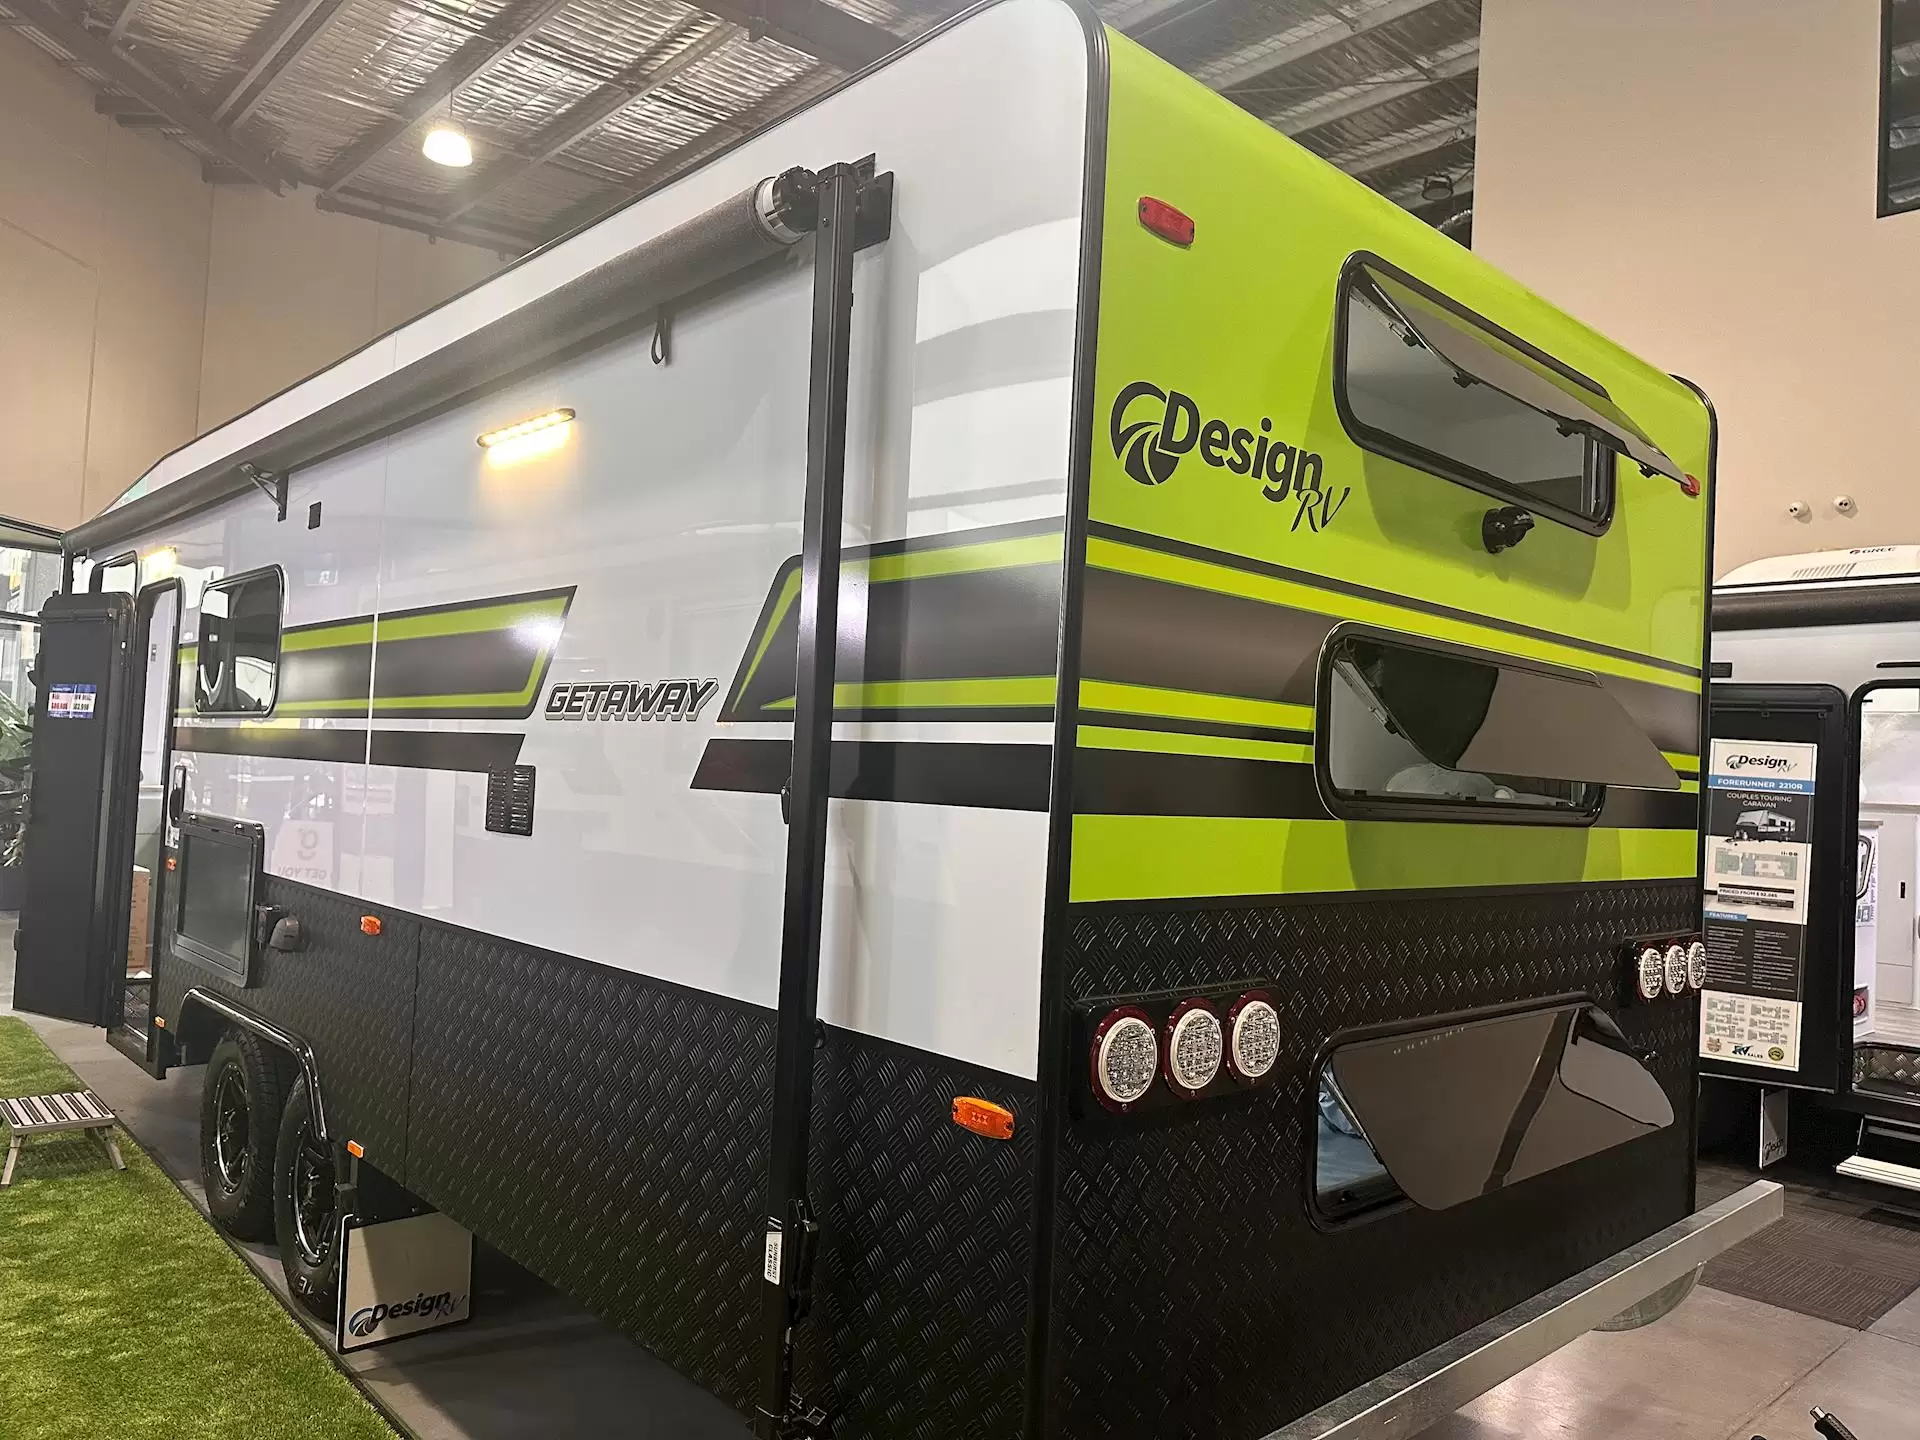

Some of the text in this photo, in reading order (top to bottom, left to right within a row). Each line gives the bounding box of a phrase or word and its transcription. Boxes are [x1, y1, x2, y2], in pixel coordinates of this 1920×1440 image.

[1157, 389, 1324, 503] Design
[1290, 485, 1352, 533] RV
[544, 677, 720, 722] GETAWAY
[1737, 754, 1788, 769] Design
[1777, 762, 1799, 774] RV
[1717, 777, 1804, 791] FORERUNNER 2210R
[1726, 791, 1793, 803] COUPLES TOURING
[1742, 800, 1777, 809] CARAVAN
[370, 1291, 451, 1323] Design
